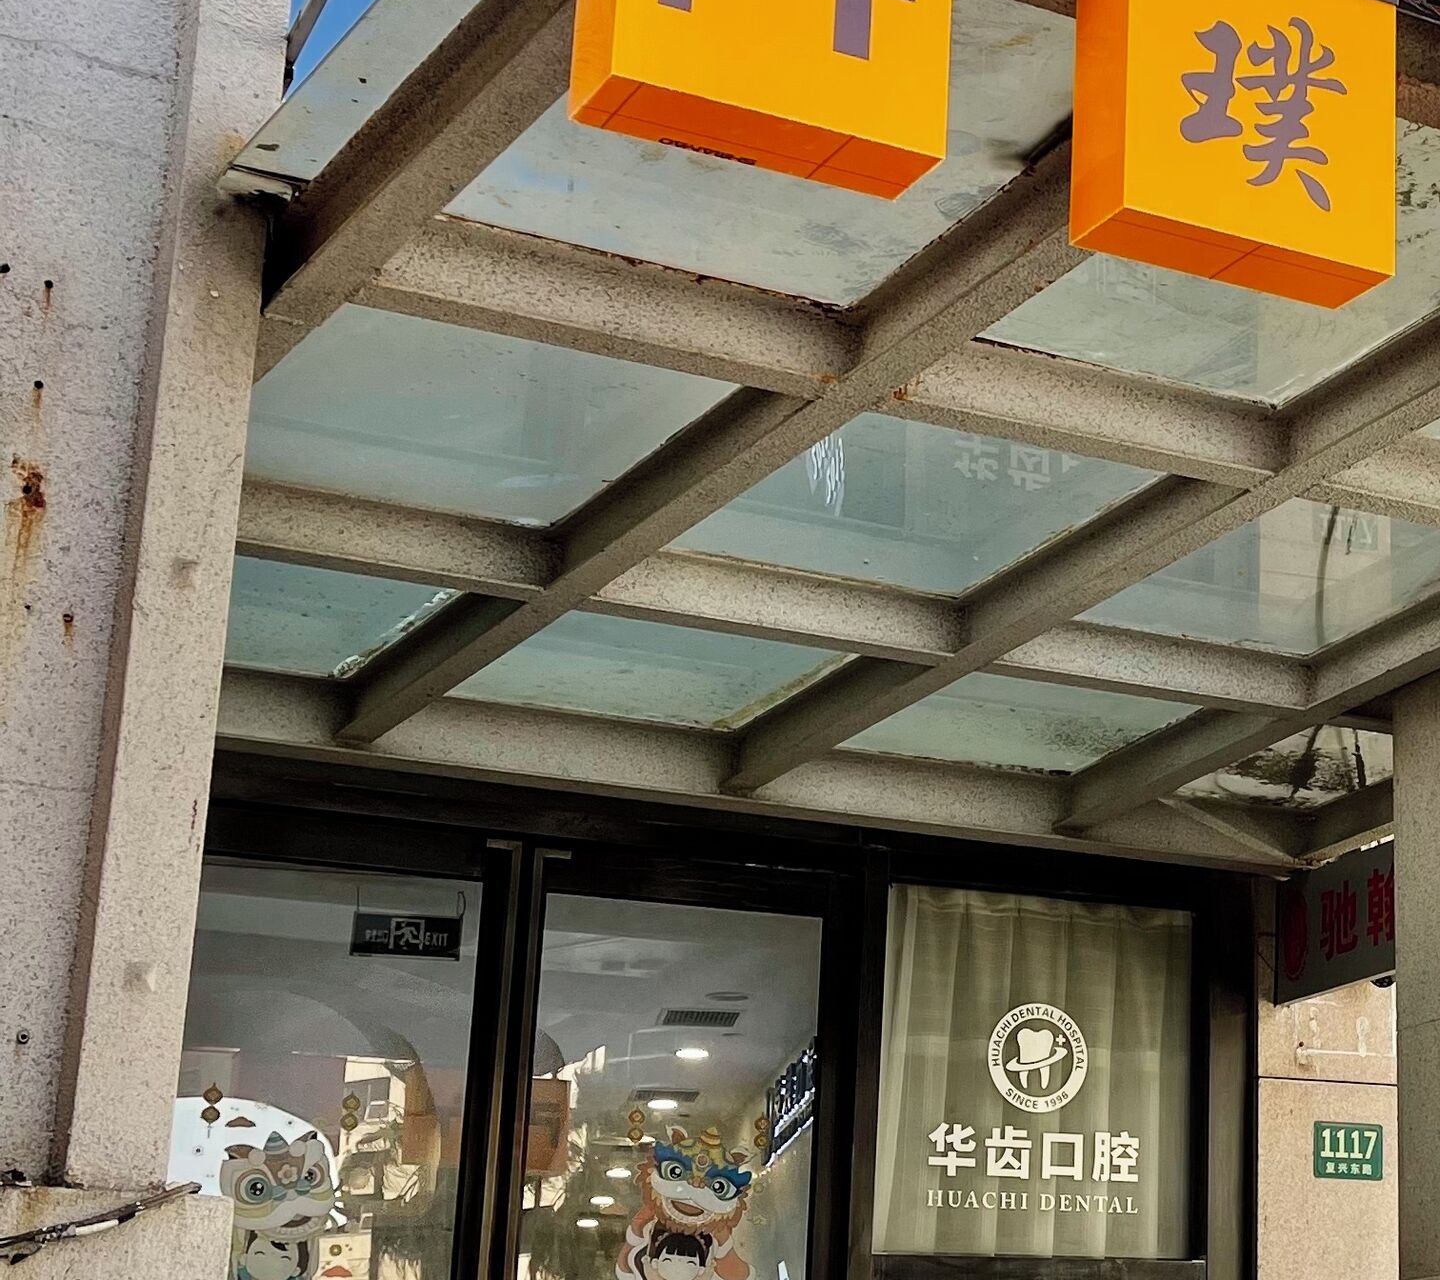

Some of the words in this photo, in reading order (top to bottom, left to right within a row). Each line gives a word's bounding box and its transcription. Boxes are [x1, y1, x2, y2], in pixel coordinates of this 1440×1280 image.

[424, 931, 449, 947] EXIT
[992, 1020, 1012, 1068] HUACHI
[1010, 1005, 1056, 1023] DENTAL
[1057, 1013, 1085, 1072] HOSPITAL
[1005, 1087, 1040, 1110] SINCE
[1044, 1090, 1070, 1109] 1996
[926, 1122, 1141, 1183] 华齿口腔
[1320, 1127, 1378, 1160] 1117
[1324, 1160, 1373, 1176] 复兴东路
[926, 1188, 1029, 1210] HUACHI
[1040, 1193, 1139, 1214] DENTAL
